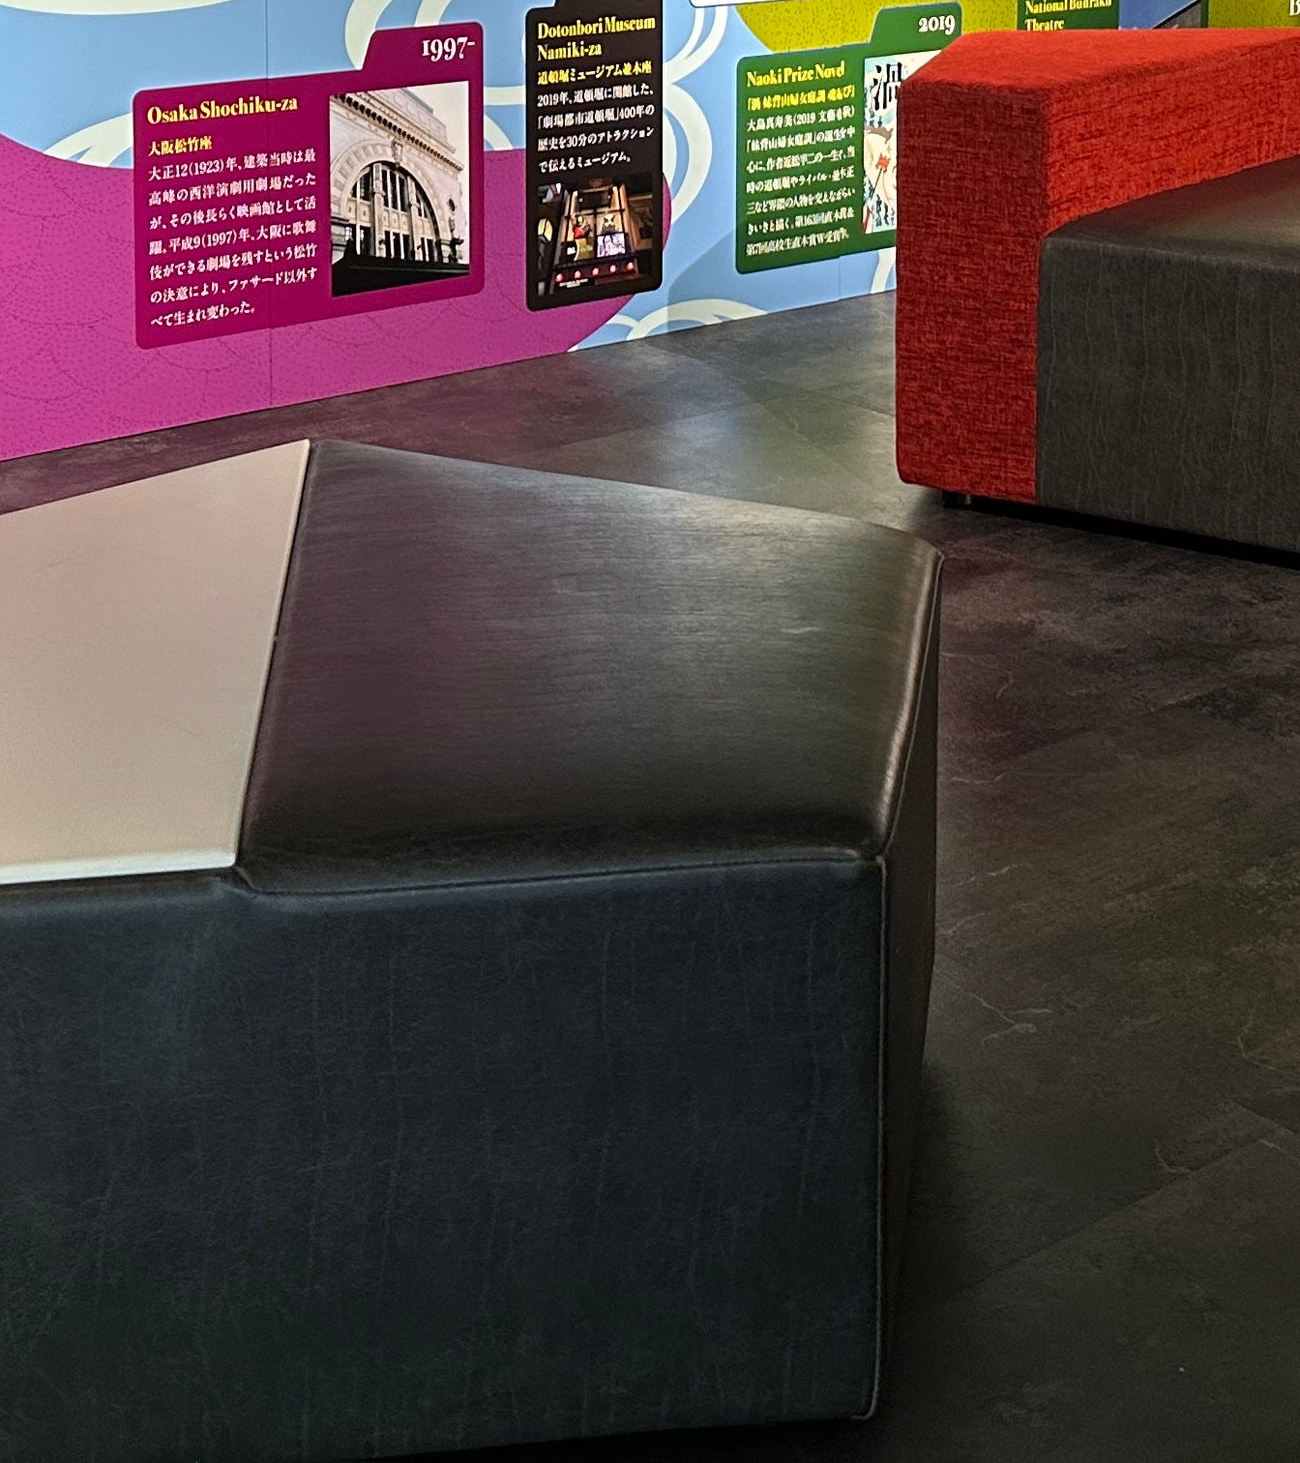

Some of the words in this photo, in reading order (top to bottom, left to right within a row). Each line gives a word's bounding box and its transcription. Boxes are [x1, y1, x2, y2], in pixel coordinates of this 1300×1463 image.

[538, 18, 603, 40] Dotonbori
[604, 15, 656, 34] Museum
[919, 15, 955, 35] 2019
[422, 37, 476, 62] 1997-
[538, 41, 602, 62] Namiki-za
[747, 68, 782, 88] Naoki
[783, 66, 814, 84] Prize
[815, 60, 845, 80] Novel
[147, 104, 198, 125] Osaka
[199, 95, 298, 119] Shochiku-za
[148, 135, 213, 157] 大阪松竹座
